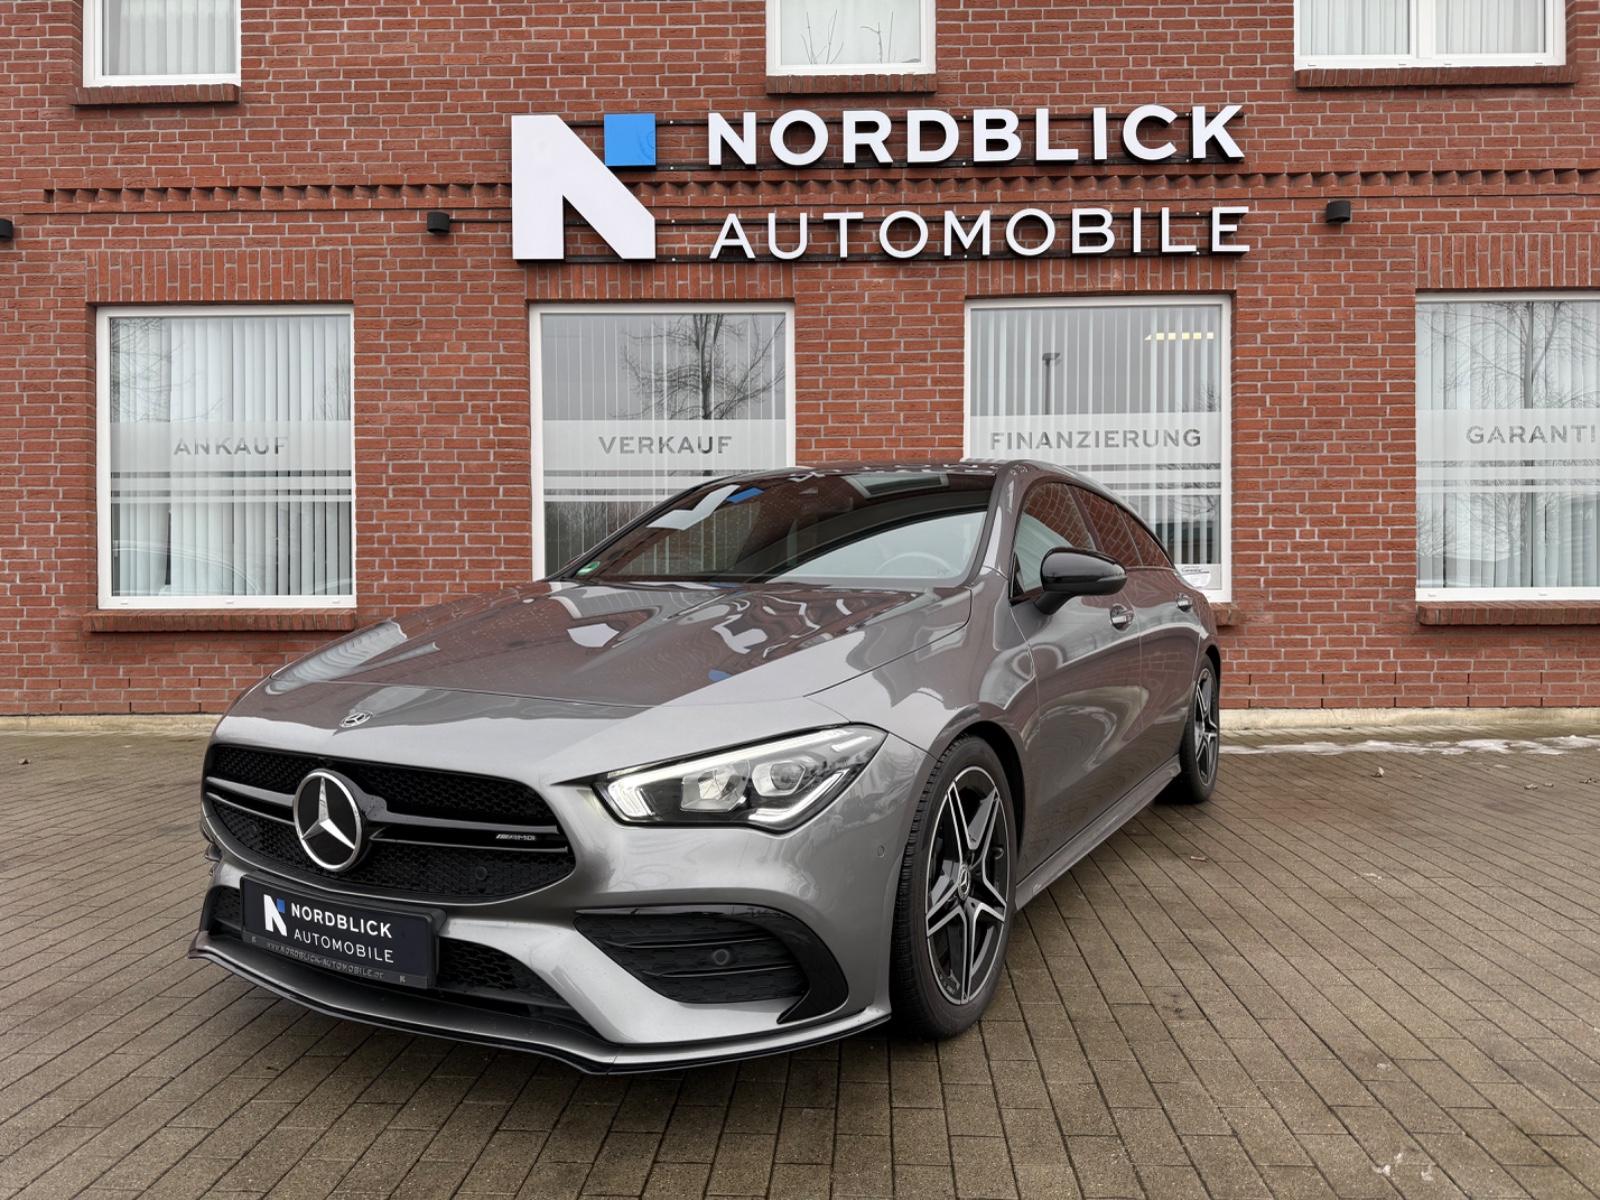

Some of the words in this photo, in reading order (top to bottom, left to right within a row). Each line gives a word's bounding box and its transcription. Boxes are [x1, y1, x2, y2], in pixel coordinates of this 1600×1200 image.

[708, 104, 1245, 167] NORDBLICK
[709, 206, 1250, 260] AUTOMOBILE
[174, 437, 288, 455] ANKAUF
[598, 436, 732, 454] VERKAUF
[990, 429, 1201, 450] FINANZIERUNG
[291, 902, 392, 939] NORDBLICK
[294, 928, 394, 964] AUTOMOBILE
